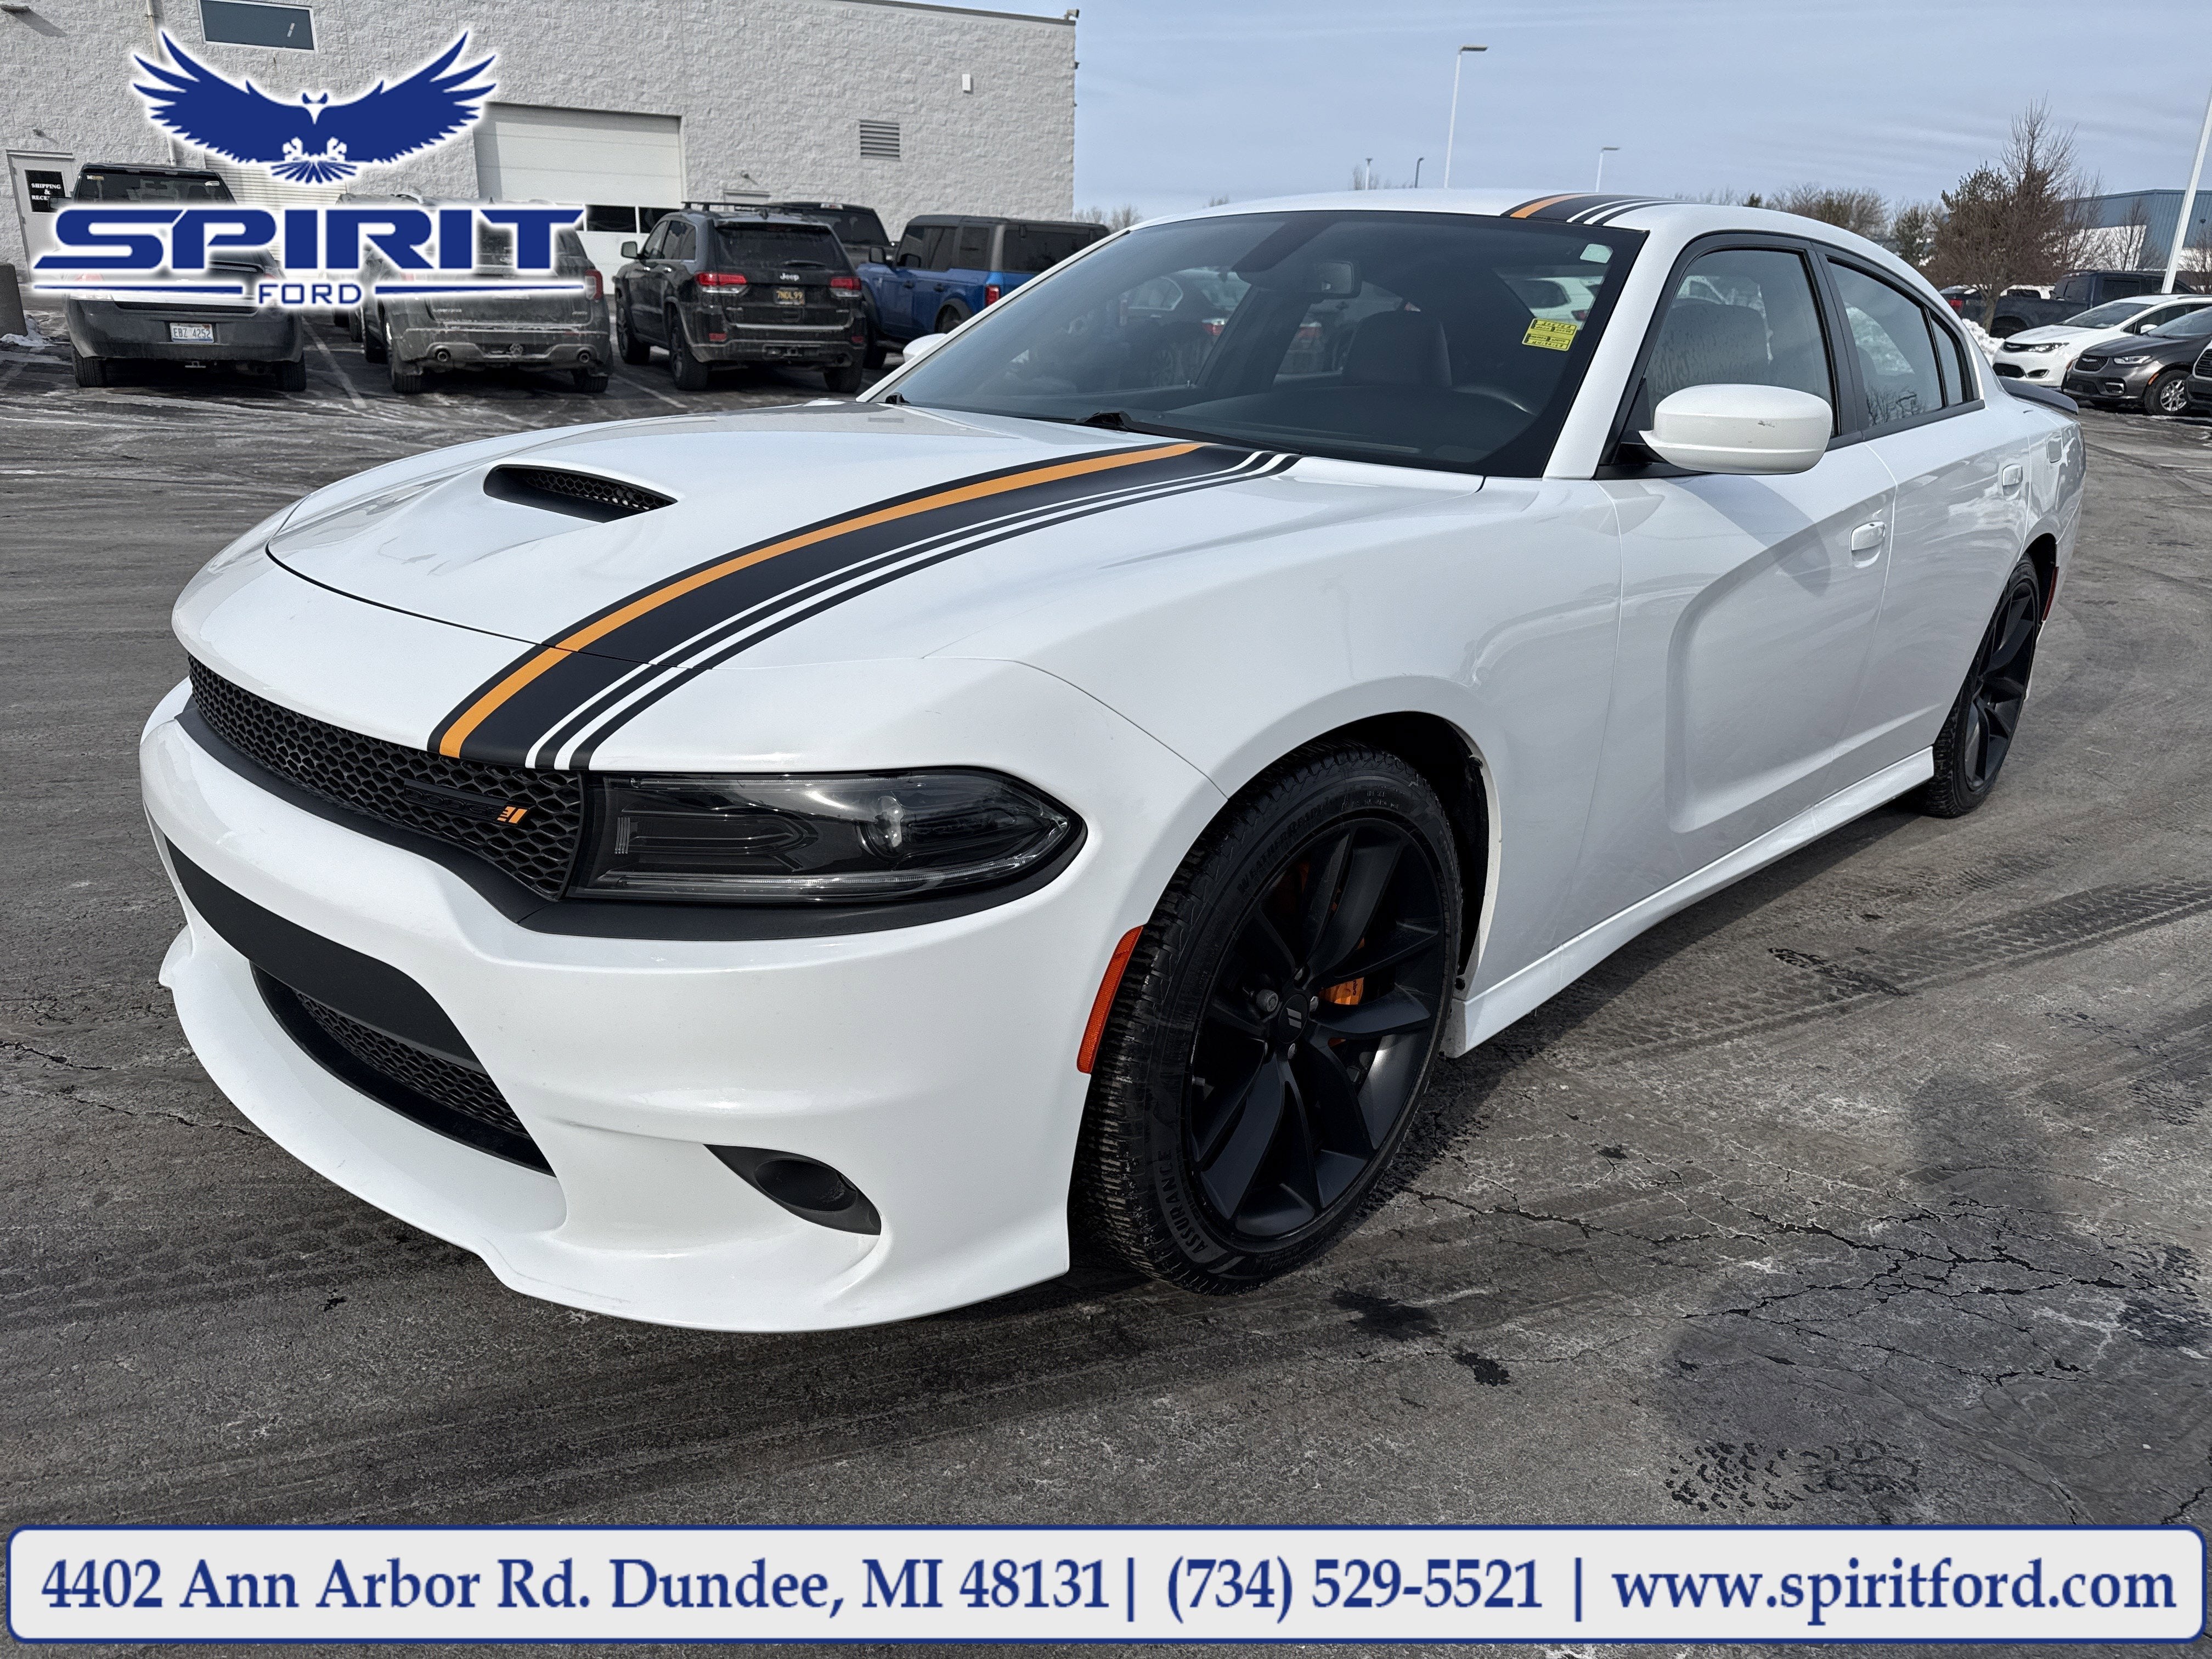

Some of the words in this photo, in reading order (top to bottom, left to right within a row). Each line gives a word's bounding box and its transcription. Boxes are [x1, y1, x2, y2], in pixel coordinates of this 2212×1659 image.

[780, 273, 800, 281] Jeep
[173, 328, 188, 338] EBZ
[192, 328, 211, 338] 4252
[1157, 1150, 1208, 1254] ASSURANCE
